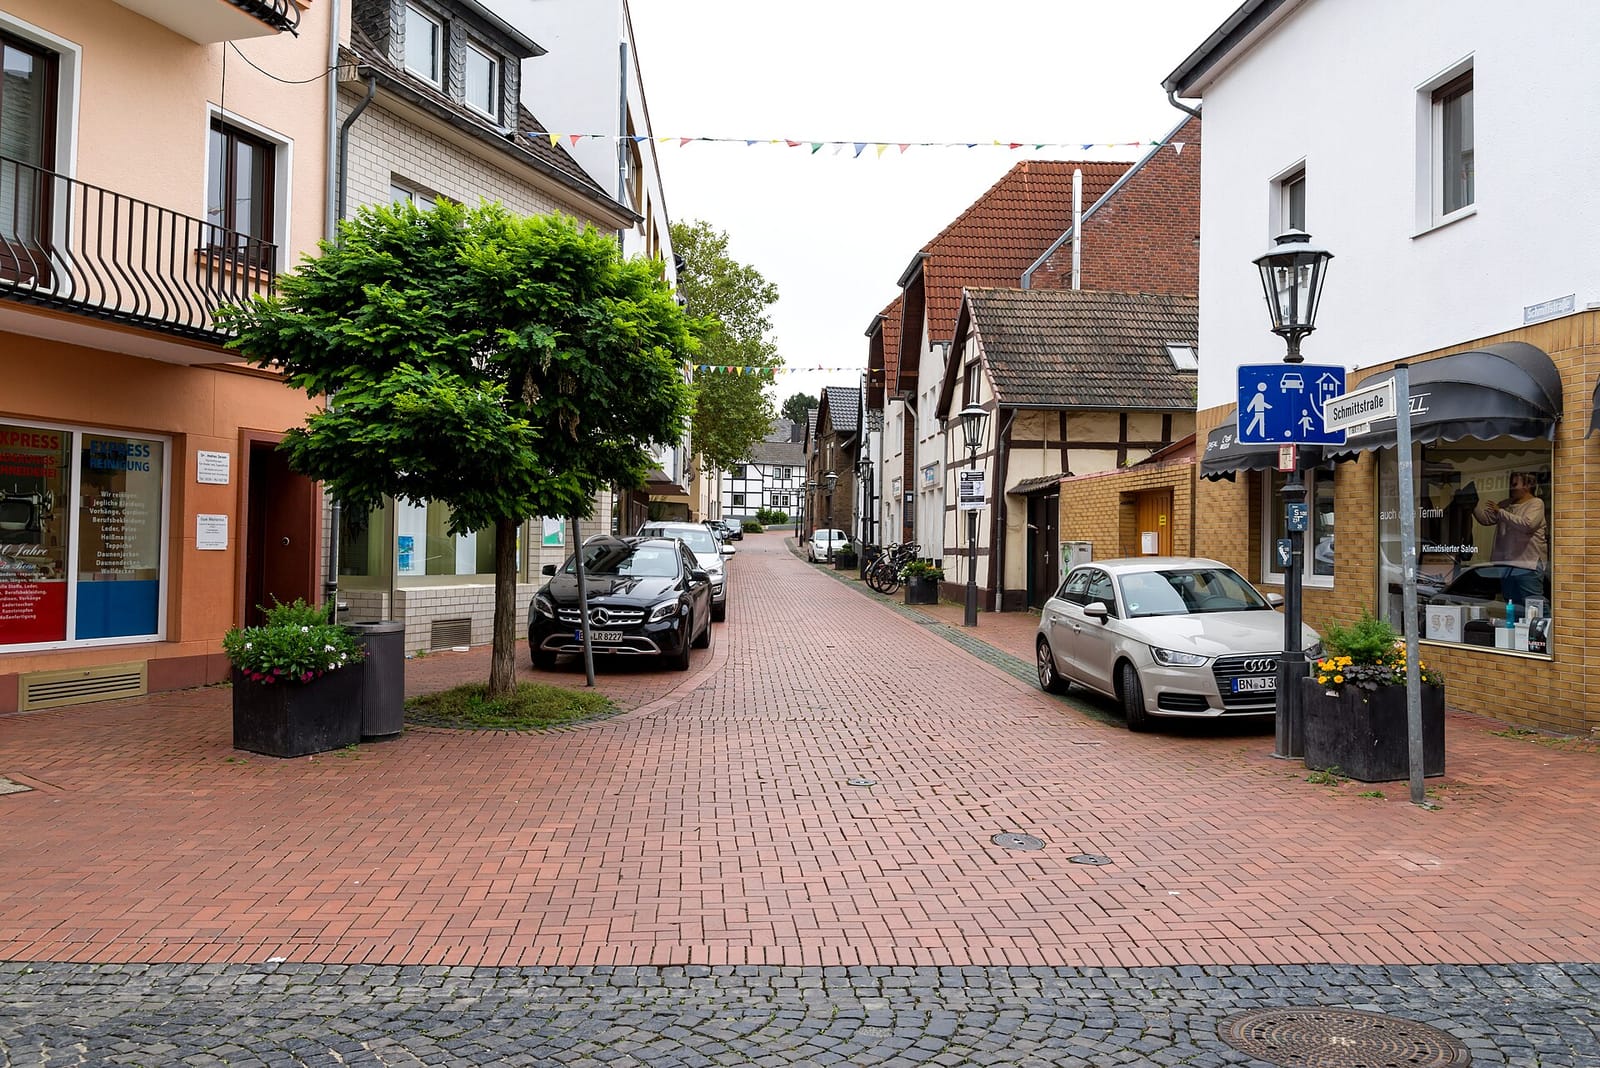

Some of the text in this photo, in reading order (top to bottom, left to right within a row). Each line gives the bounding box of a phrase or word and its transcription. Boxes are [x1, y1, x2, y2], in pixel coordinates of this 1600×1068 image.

[1333, 395, 1384, 421] Schmittstraße
[90, 440, 150, 457] EXPRESS
[90, 459, 150, 472] REINIGUNG
[1380, 509, 1397, 520] auch
[1418, 507, 1443, 519] Termin
[15, 543, 48, 558] Jahre
[1422, 544, 1478, 553] Klimatisierter Salon
[593, 632, 603, 640] LR
[604, 633, 622, 641] 8227
[1239, 680, 1253, 690] BN
[1260, 678, 1266, 688] J
